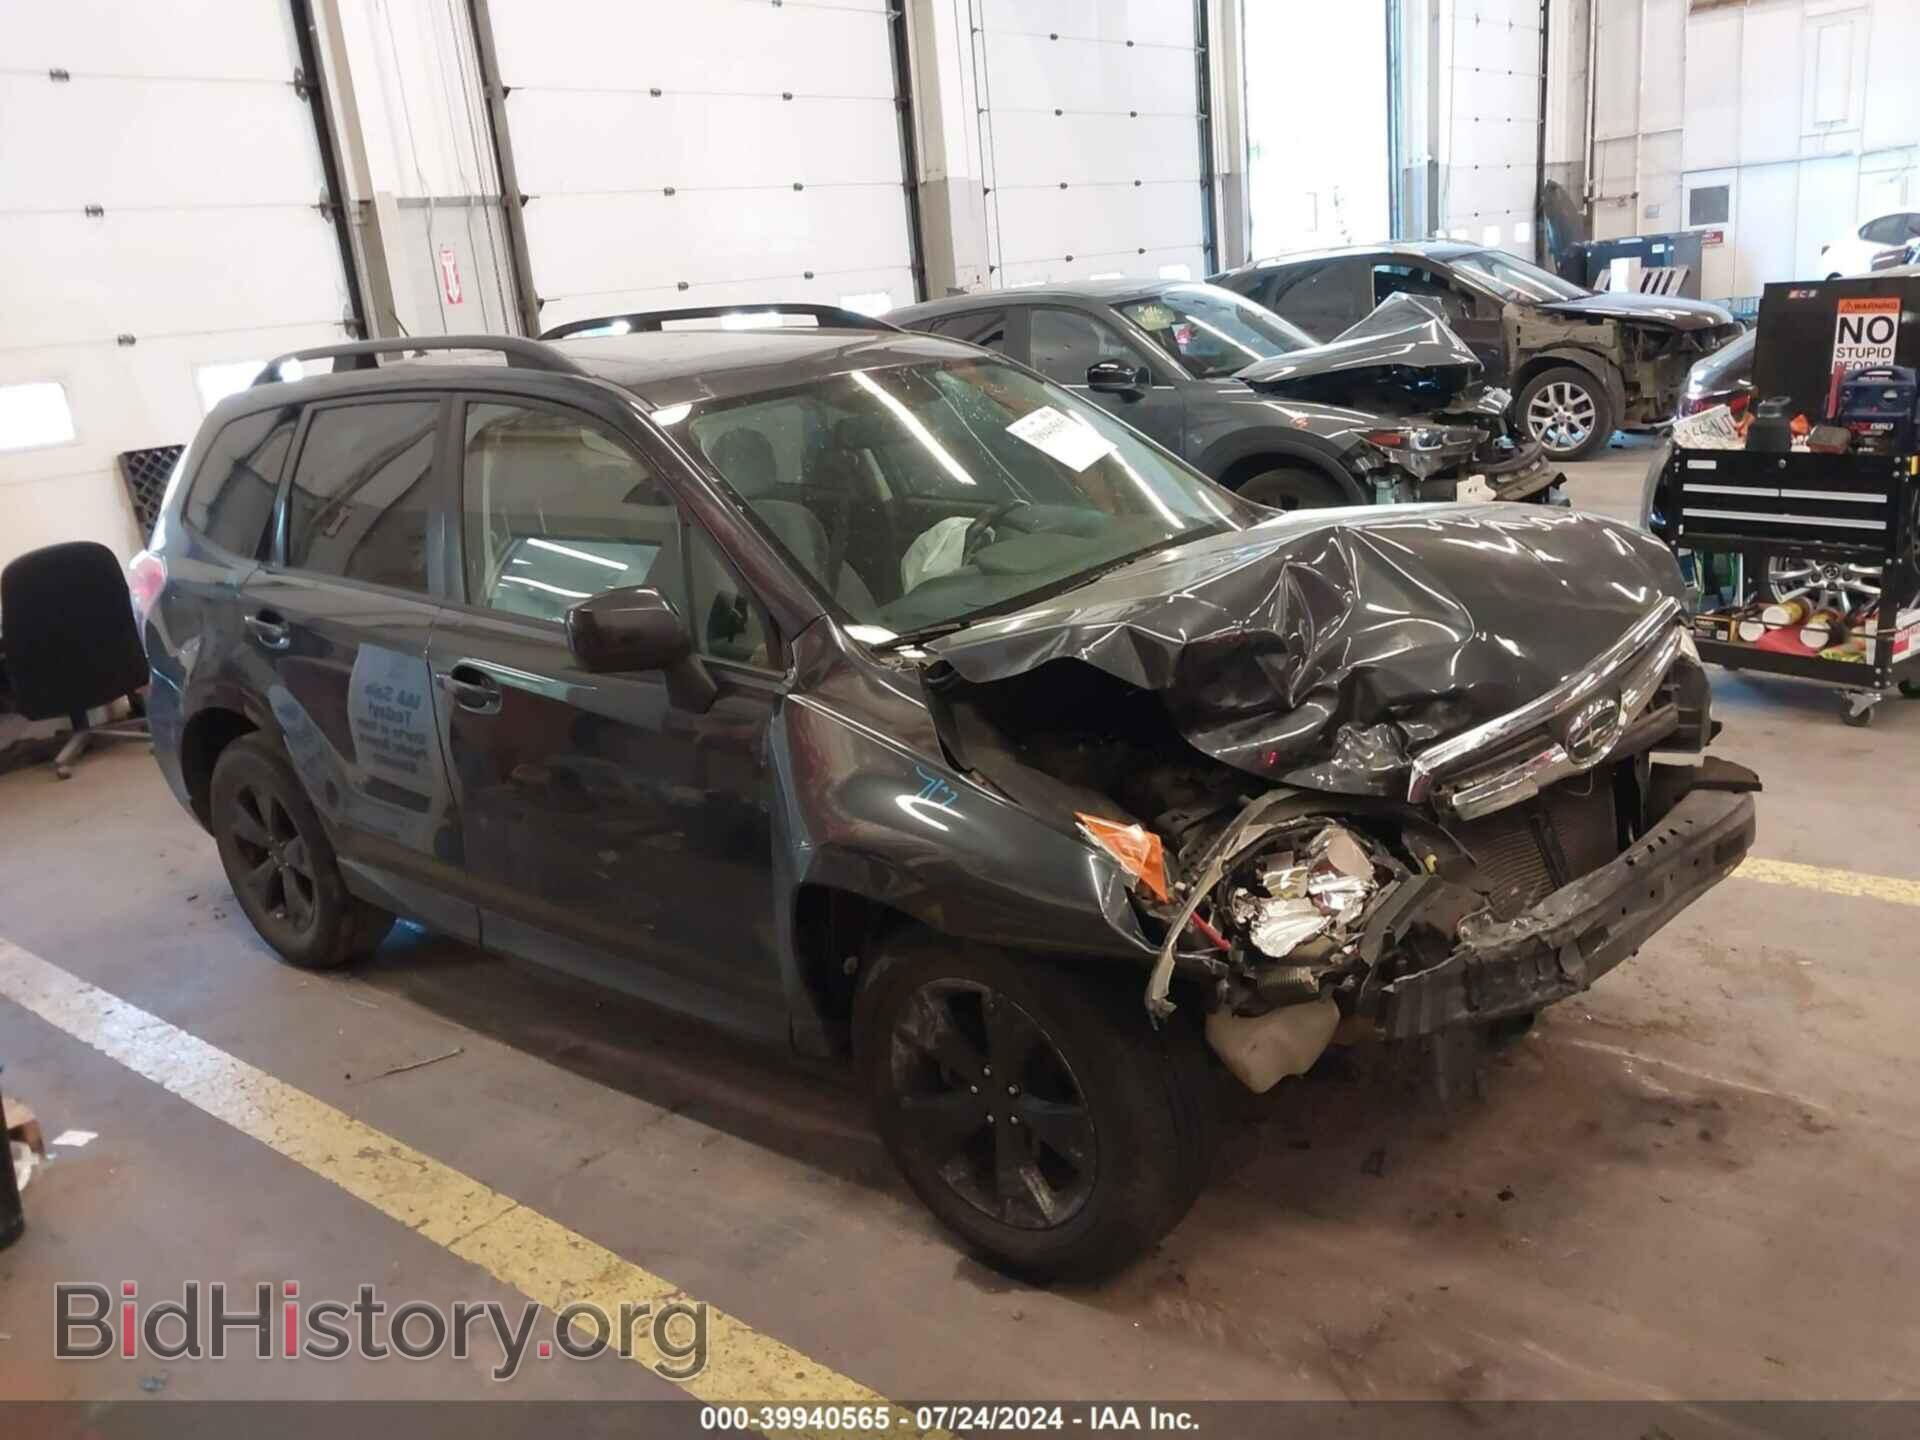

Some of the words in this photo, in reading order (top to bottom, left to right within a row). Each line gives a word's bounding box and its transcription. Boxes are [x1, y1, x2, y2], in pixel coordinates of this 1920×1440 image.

[1854, 301, 1898, 310] WARNING
[1837, 315, 1895, 345] NO
[1835, 347, 1892, 359] STUPID
